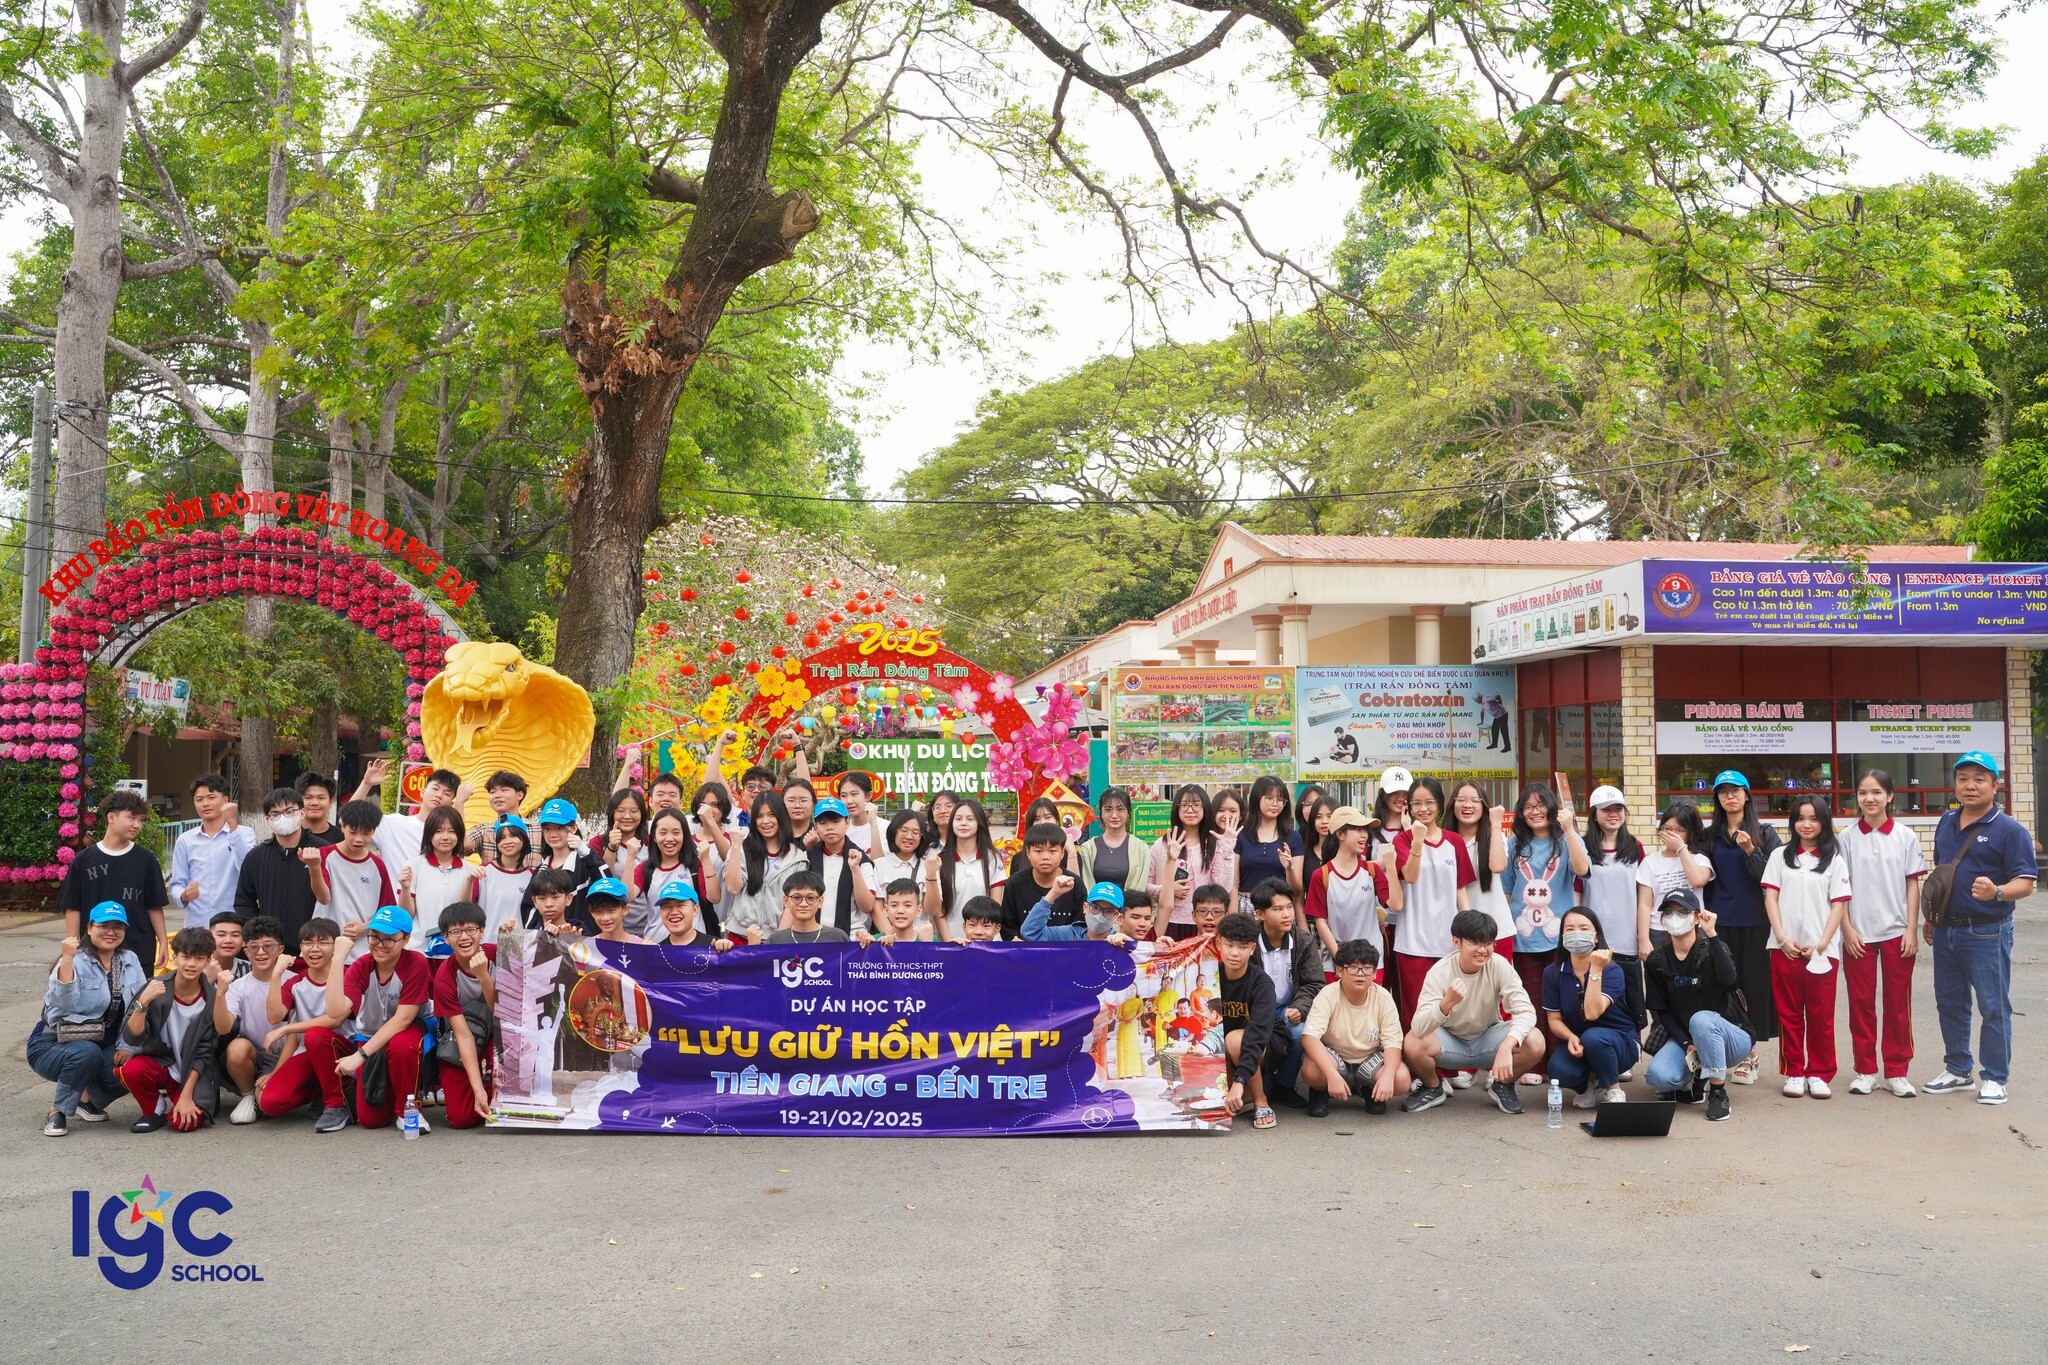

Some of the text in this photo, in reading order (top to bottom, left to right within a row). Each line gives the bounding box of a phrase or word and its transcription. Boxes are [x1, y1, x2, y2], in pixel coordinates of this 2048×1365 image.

[38, 552, 93, 607] KHU
[88, 519, 147, 566] BẢO
[146, 490, 205, 534] TỒN
[210, 483, 291, 521] ĐỘNG
[296, 491, 348, 528] VẬT
[347, 509, 441, 576] HOANG
[1711, 568, 1755, 584] BẢNG
[1757, 570, 1786, 584] GIÁ
[1788, 570, 1810, 584] VÉ
[1812, 570, 1844, 584] VÀO
[1905, 573, 2042, 585] ENTRANCE TICKET
[1672, 580, 1680, 590] 9
[1712, 588, 1834, 598] Cao 1m đến dưới 1.3m:
[1906, 590, 2048, 599] From 1m to under 1.3m: VND
[1713, 600, 1894, 610] Cao từ 1.3m trở lên VNĐ
[1907, 602, 2047, 611] From 1.3m VND
[1993, 617, 2025, 626] refund
[844, 622, 943, 657] 2025
[810, 660, 968, 681] Trại Rắn Đồng Tâm
[1359, 693, 1465, 708] Cobratoxan
[1684, 701, 1804, 719] PHÒNG BÁN VÉ
[1867, 704, 1973, 719] TICKET PRICE
[1695, 722, 1793, 732] BẢNG GIÁ VÉ VÀO CỔNG
[869, 744, 910, 759] KHU
[918, 744, 945, 759] DU
[893, 762, 928, 793] RẮN
[932, 762, 978, 793] ĐỒNG
[1532, 910, 1541, 923] C
[848, 960, 944, 970] TRƯỜNG TH-THCS-THPT
[848, 970, 944, 980] THÁI BÌNH DƯƠNG (IPS)
[791, 996, 926, 1016] DỰ ÁN HỌC TẬP
[768, 1024, 843, 1059] GIỮ
[851, 1018, 939, 1060] HỒN
[710, 1064, 1047, 1100] TIỀN GIANG - BẾN TRE
[779, 1109, 923, 1128] 19-21/02/2025
